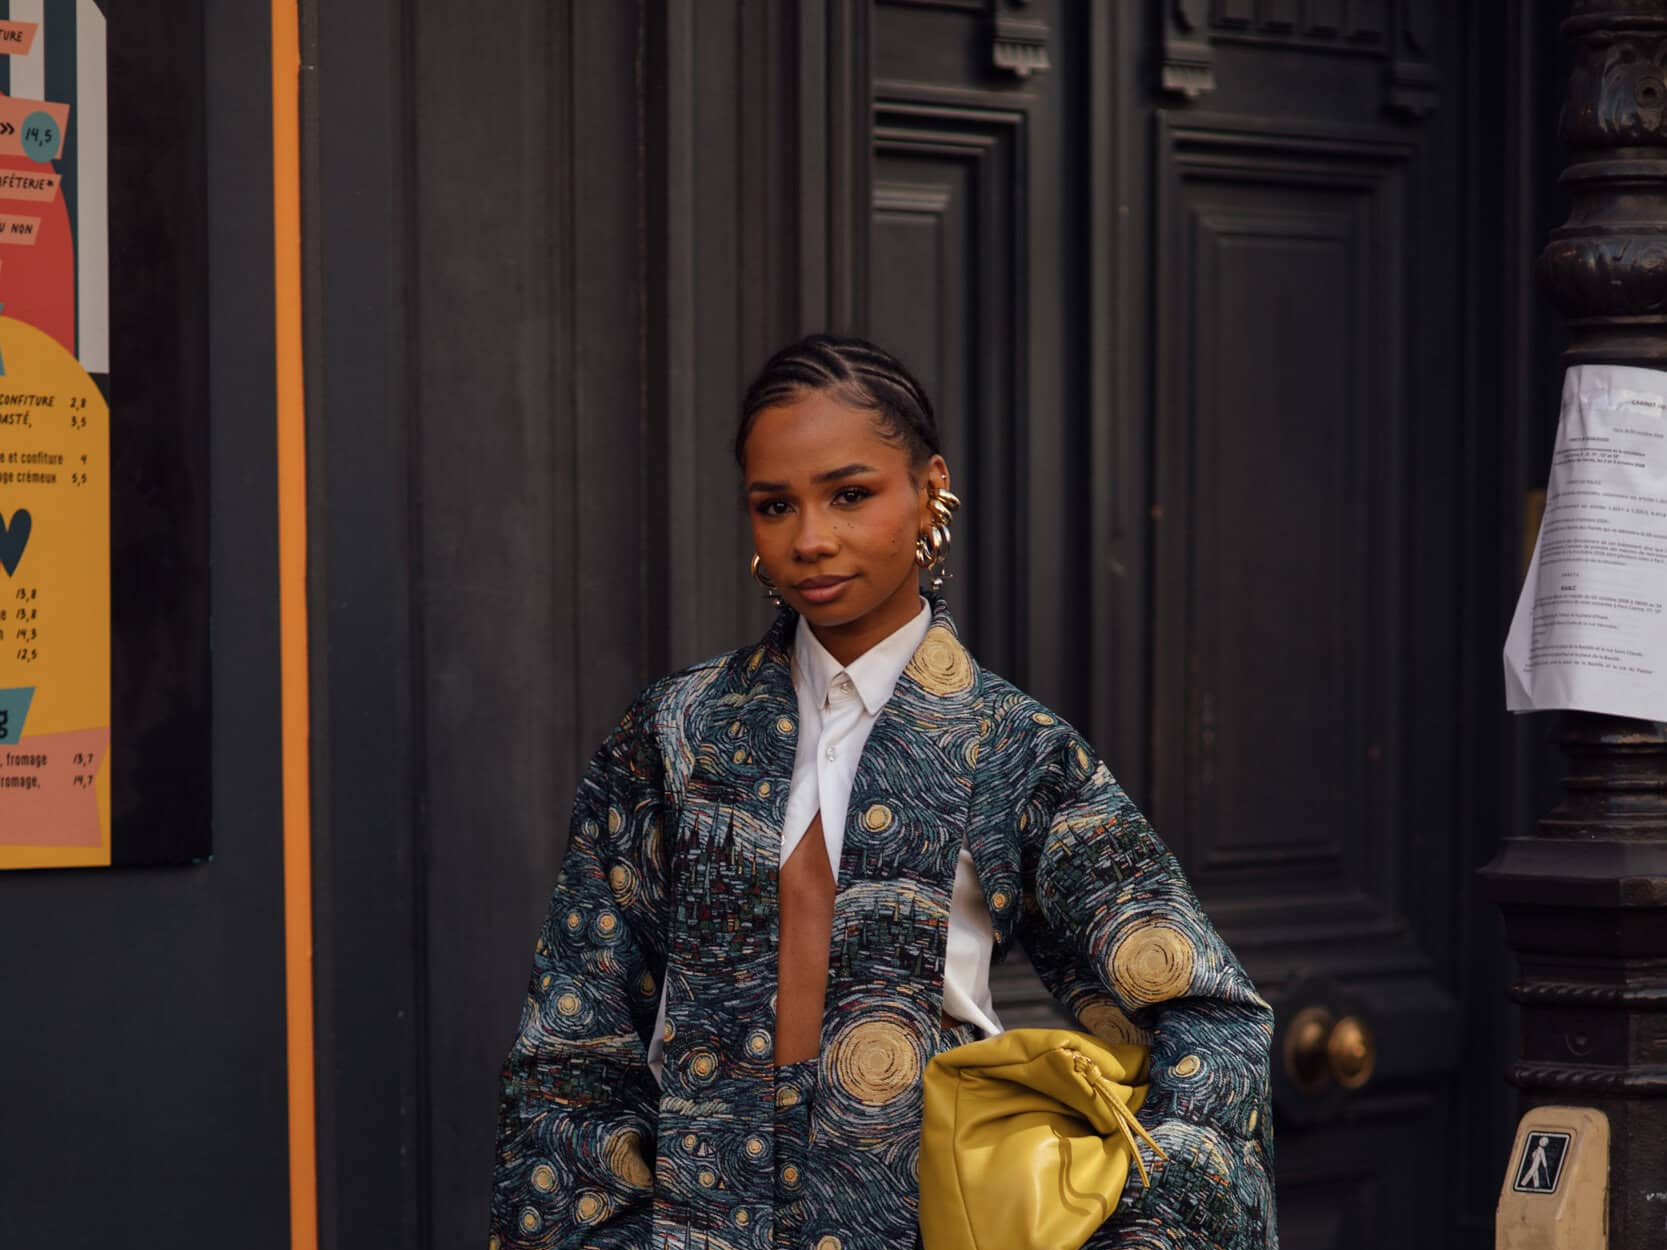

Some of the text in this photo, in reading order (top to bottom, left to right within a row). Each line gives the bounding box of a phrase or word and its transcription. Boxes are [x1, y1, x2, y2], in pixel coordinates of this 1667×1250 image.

[24, 127, 53, 147] 14,5
[11, 223, 33, 235] NON
[8, 451, 18, 464] et
[21, 451, 64, 465] confiture
[6, 752, 48, 769] fromage
